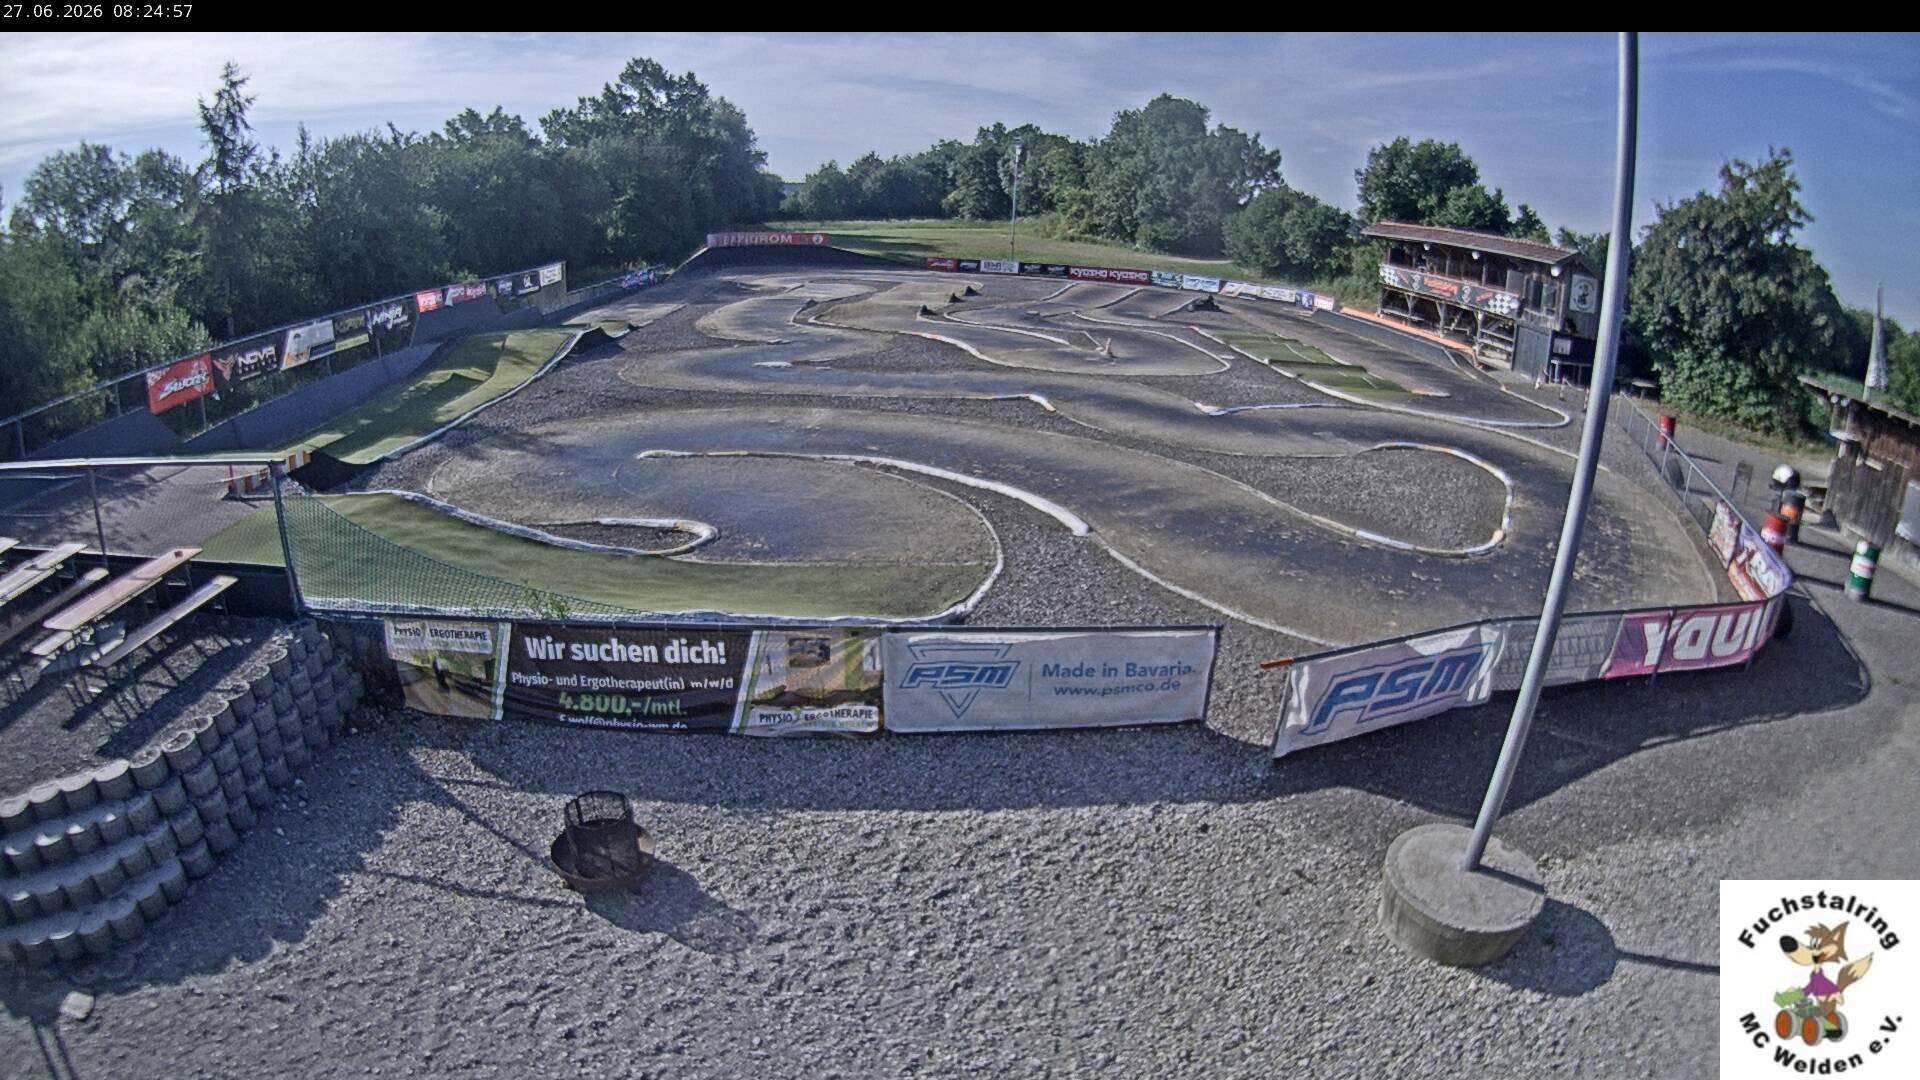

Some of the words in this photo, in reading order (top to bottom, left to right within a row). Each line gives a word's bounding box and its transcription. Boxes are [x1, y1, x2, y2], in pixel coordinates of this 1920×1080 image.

[238, 345, 276, 366] NOVA
[429, 628, 488, 641] ERGOTHERAPIE
[525, 636, 565, 660] Wir
[571, 637, 658, 663] suchen
[664, 638, 727, 664] dich!
[906, 664, 1013, 685] PSM
[1042, 662, 1099, 678] Made
[1103, 661, 1118, 678] in
[511, 671, 553, 687] Physio-
[556, 674, 577, 687] und
[581, 674, 685, 691] Ergotherapeut(in)
[690, 677, 734, 689] m/w/d
[1054, 677, 1181, 697] www.psmco.de
[1311, 651, 1484, 728] PSM
[558, 691, 688, 717] 4.800,-/mtl.
[759, 713, 793, 724] PHYSIO
[804, 708, 874, 721] ERGOTHERAPIE
